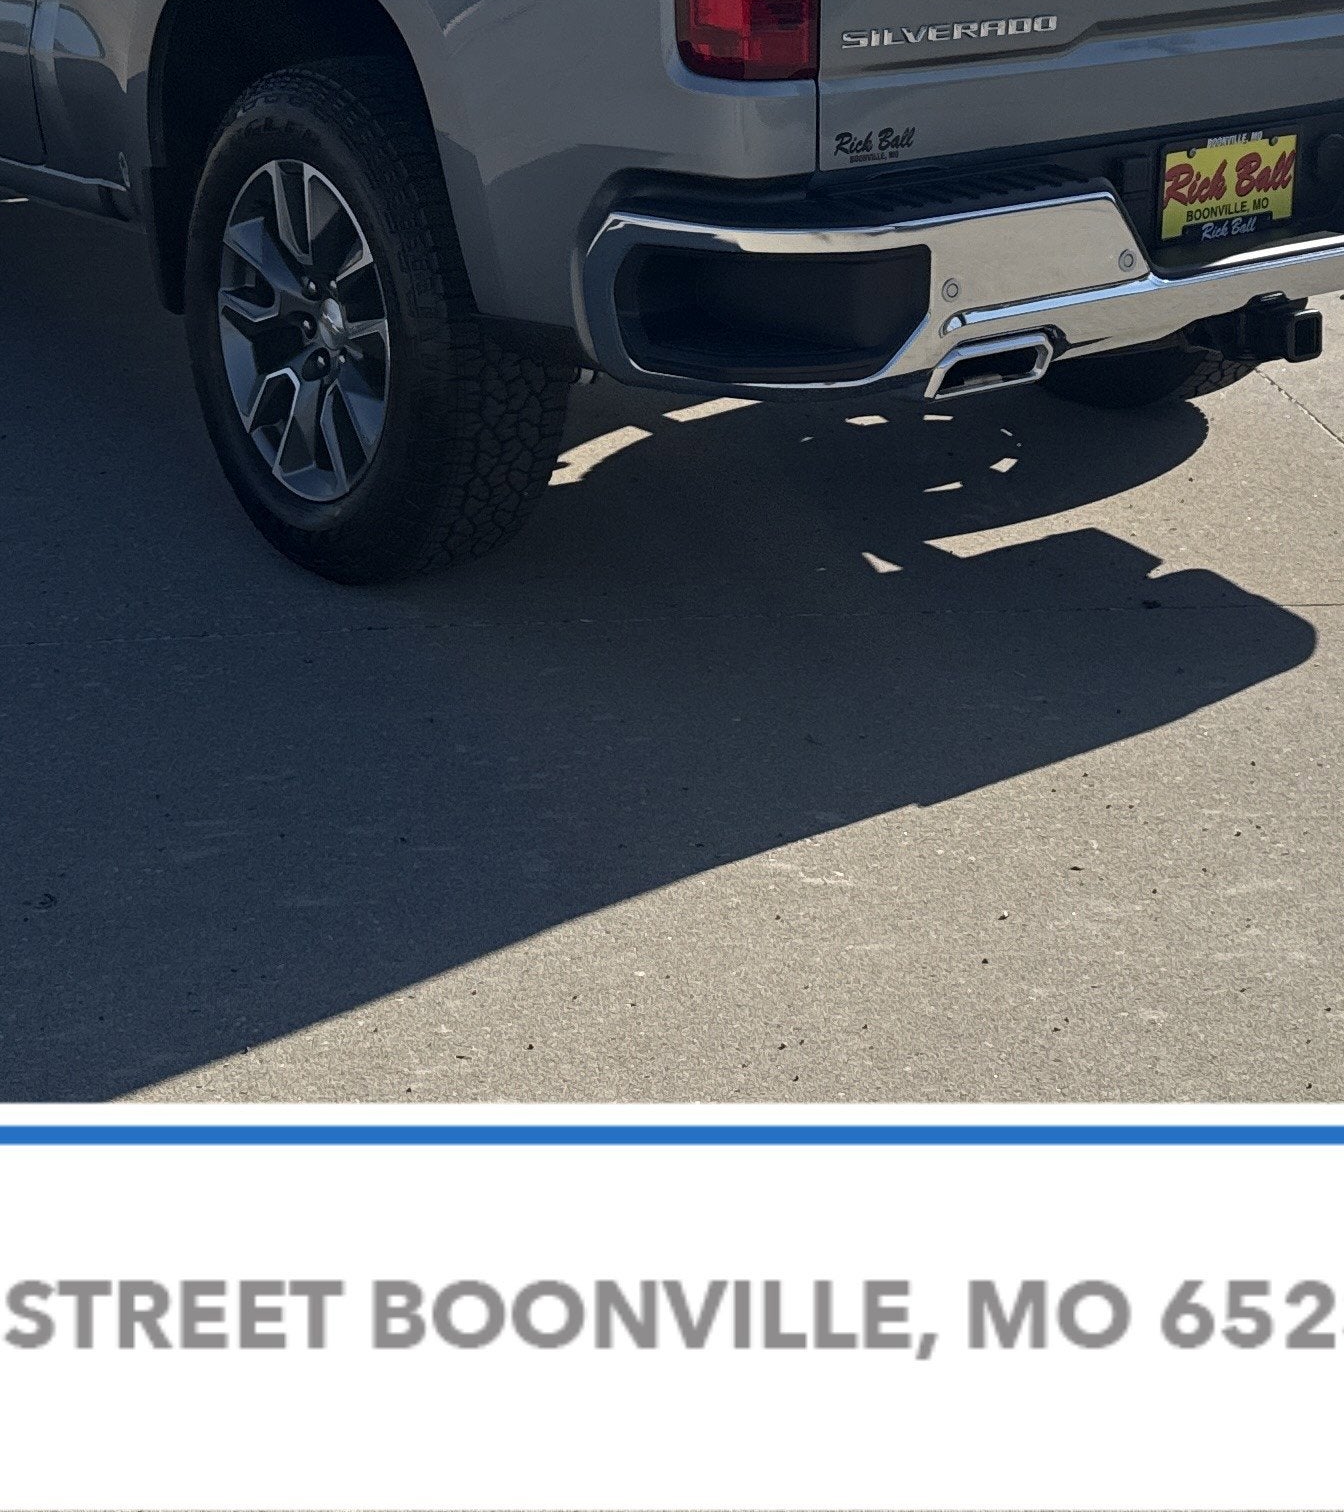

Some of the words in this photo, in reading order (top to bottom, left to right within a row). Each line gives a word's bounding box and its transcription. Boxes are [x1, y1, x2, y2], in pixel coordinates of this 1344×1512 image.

[841, 14, 1058, 50] SILVERADO
[834, 131, 873, 156] Rick
[878, 127, 916, 150] Ball
[1251, 131, 1263, 141] MO
[1163, 159, 1228, 210] Rick
[1235, 149, 1297, 198] Ball
[1186, 201, 1250, 222] BOONVILLE,
[1252, 197, 1269, 211] MO
[1201, 219, 1229, 240] Rick
[1231, 216, 1257, 235] Ball
